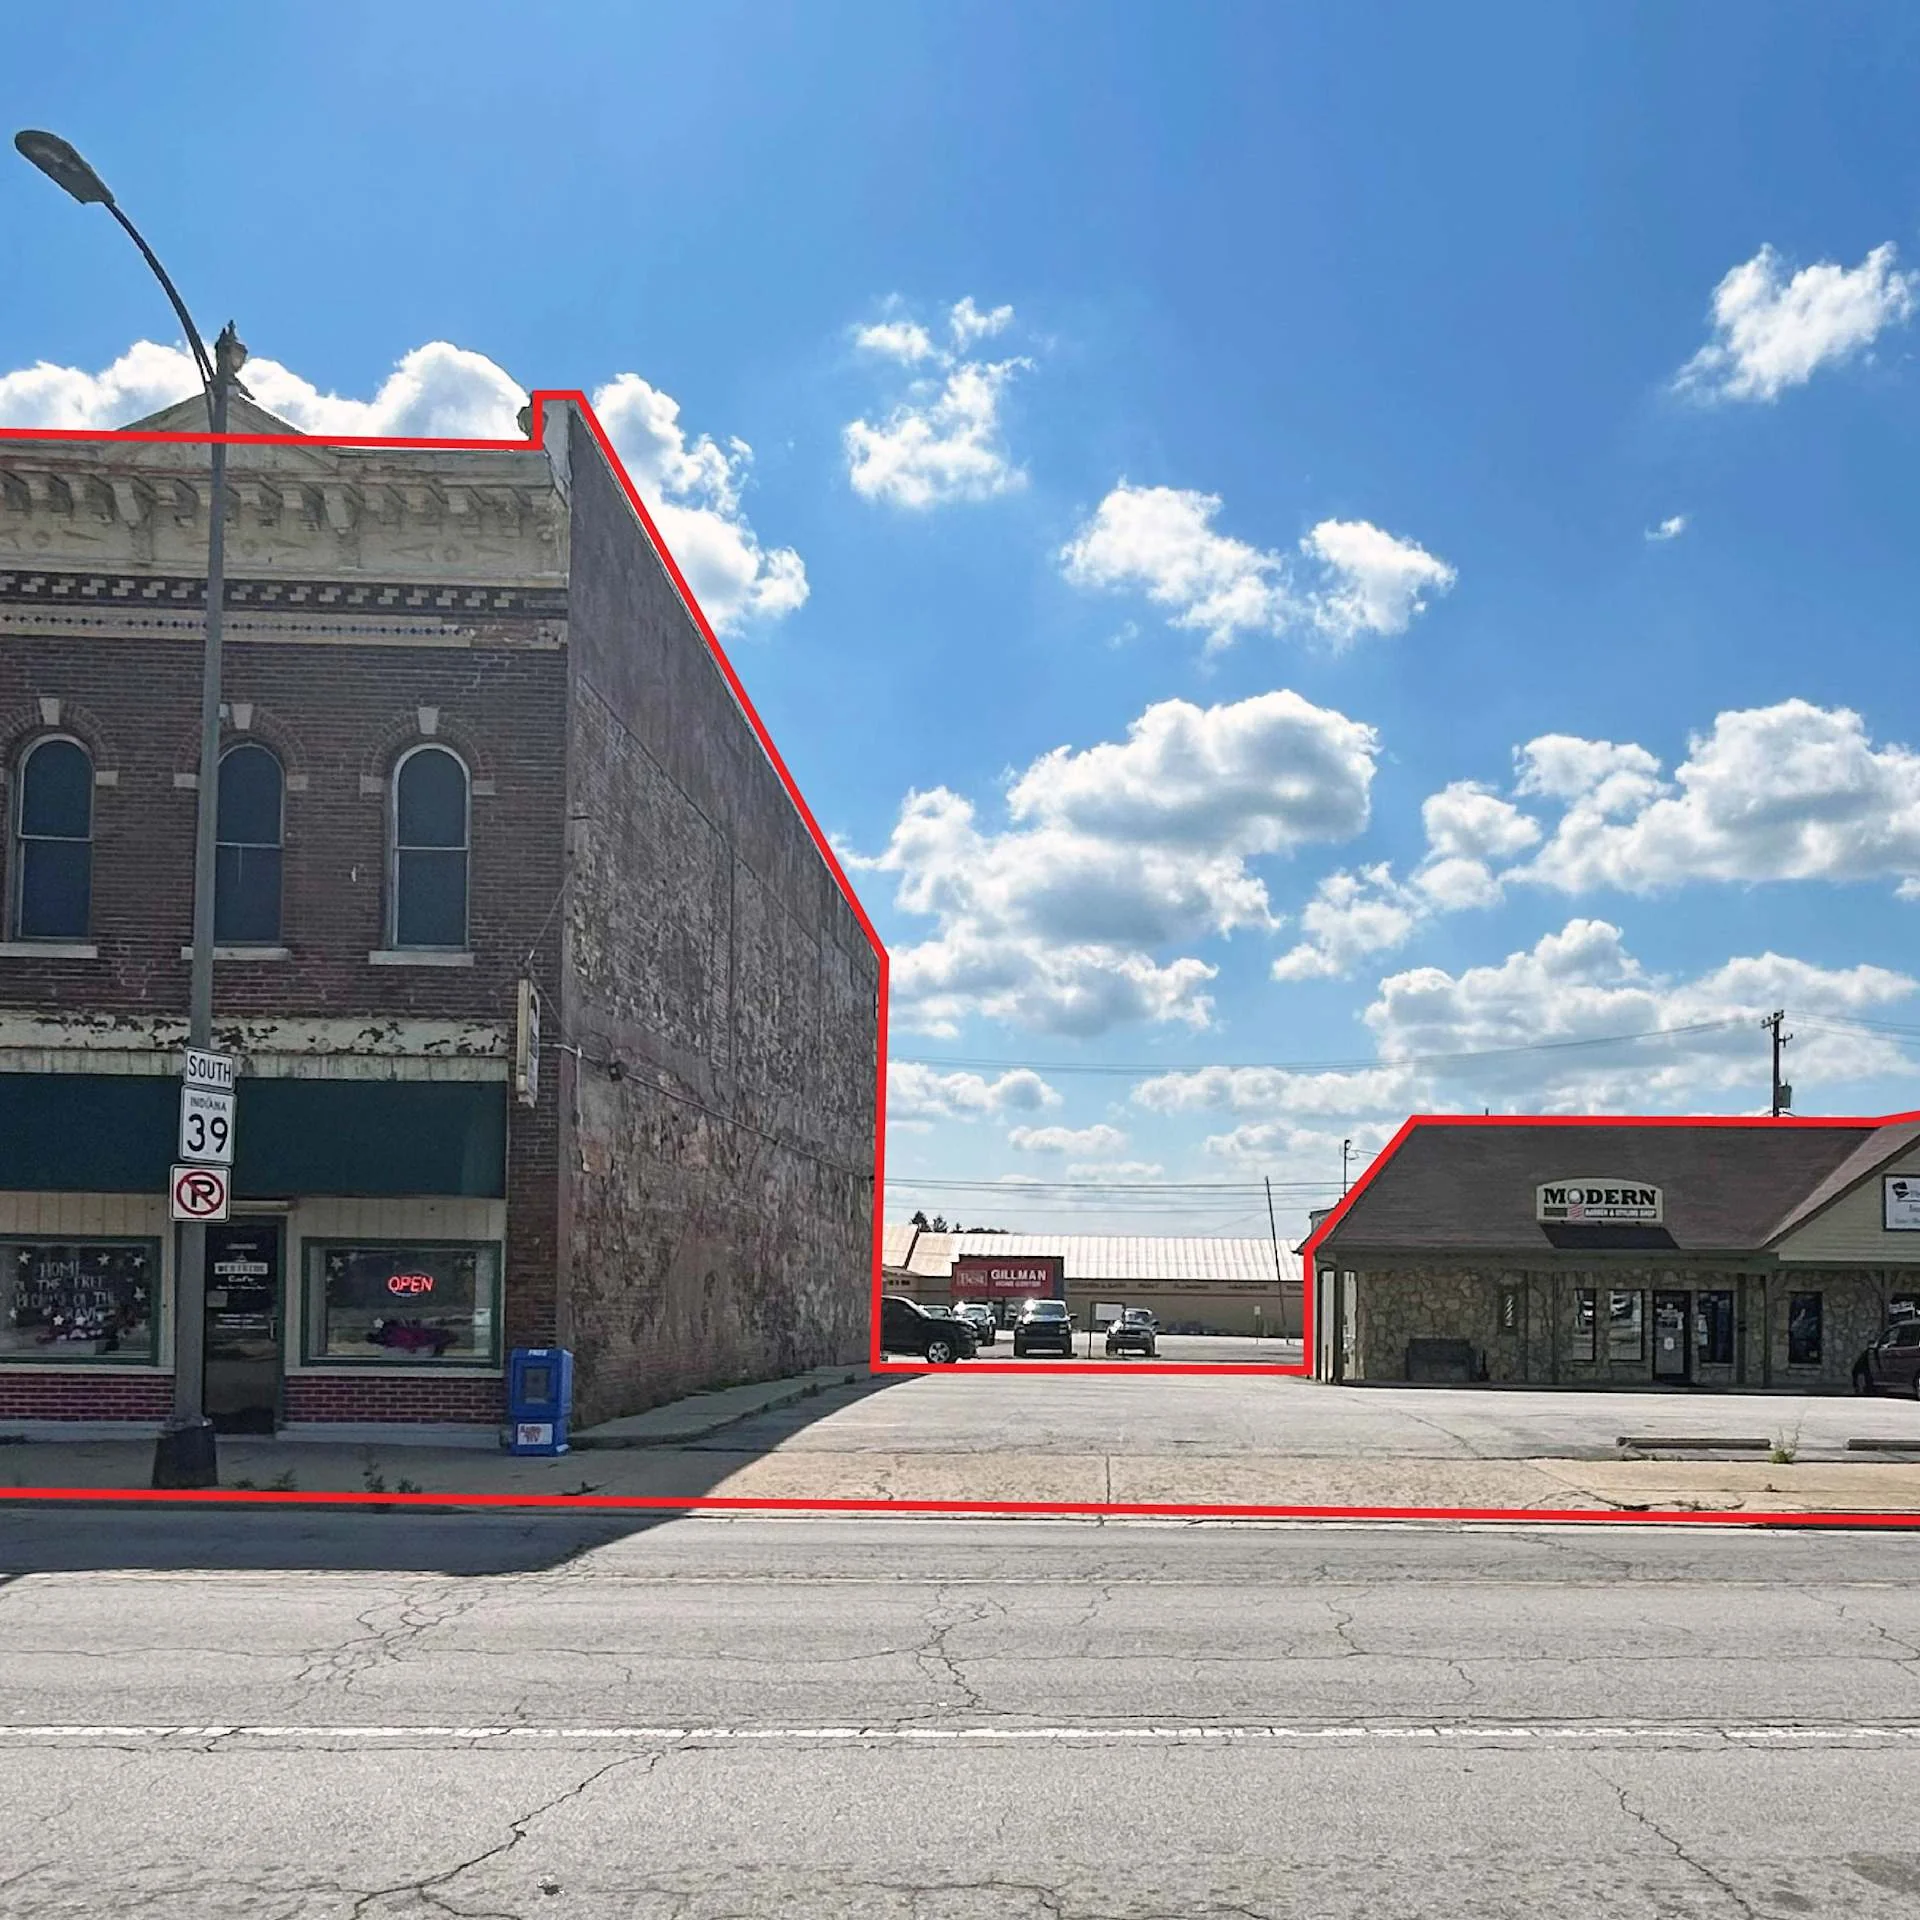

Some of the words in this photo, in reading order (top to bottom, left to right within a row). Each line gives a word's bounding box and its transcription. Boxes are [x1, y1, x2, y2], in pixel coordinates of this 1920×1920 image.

[188, 1054, 232, 1083] SOUTH
[190, 1096, 228, 1112] INDIANA
[187, 1113, 229, 1154] 39
[1543, 1187, 1656, 1206] MODERN
[388, 1275, 434, 1292] OPEN
[990, 1268, 1047, 1281] GILLMAN
